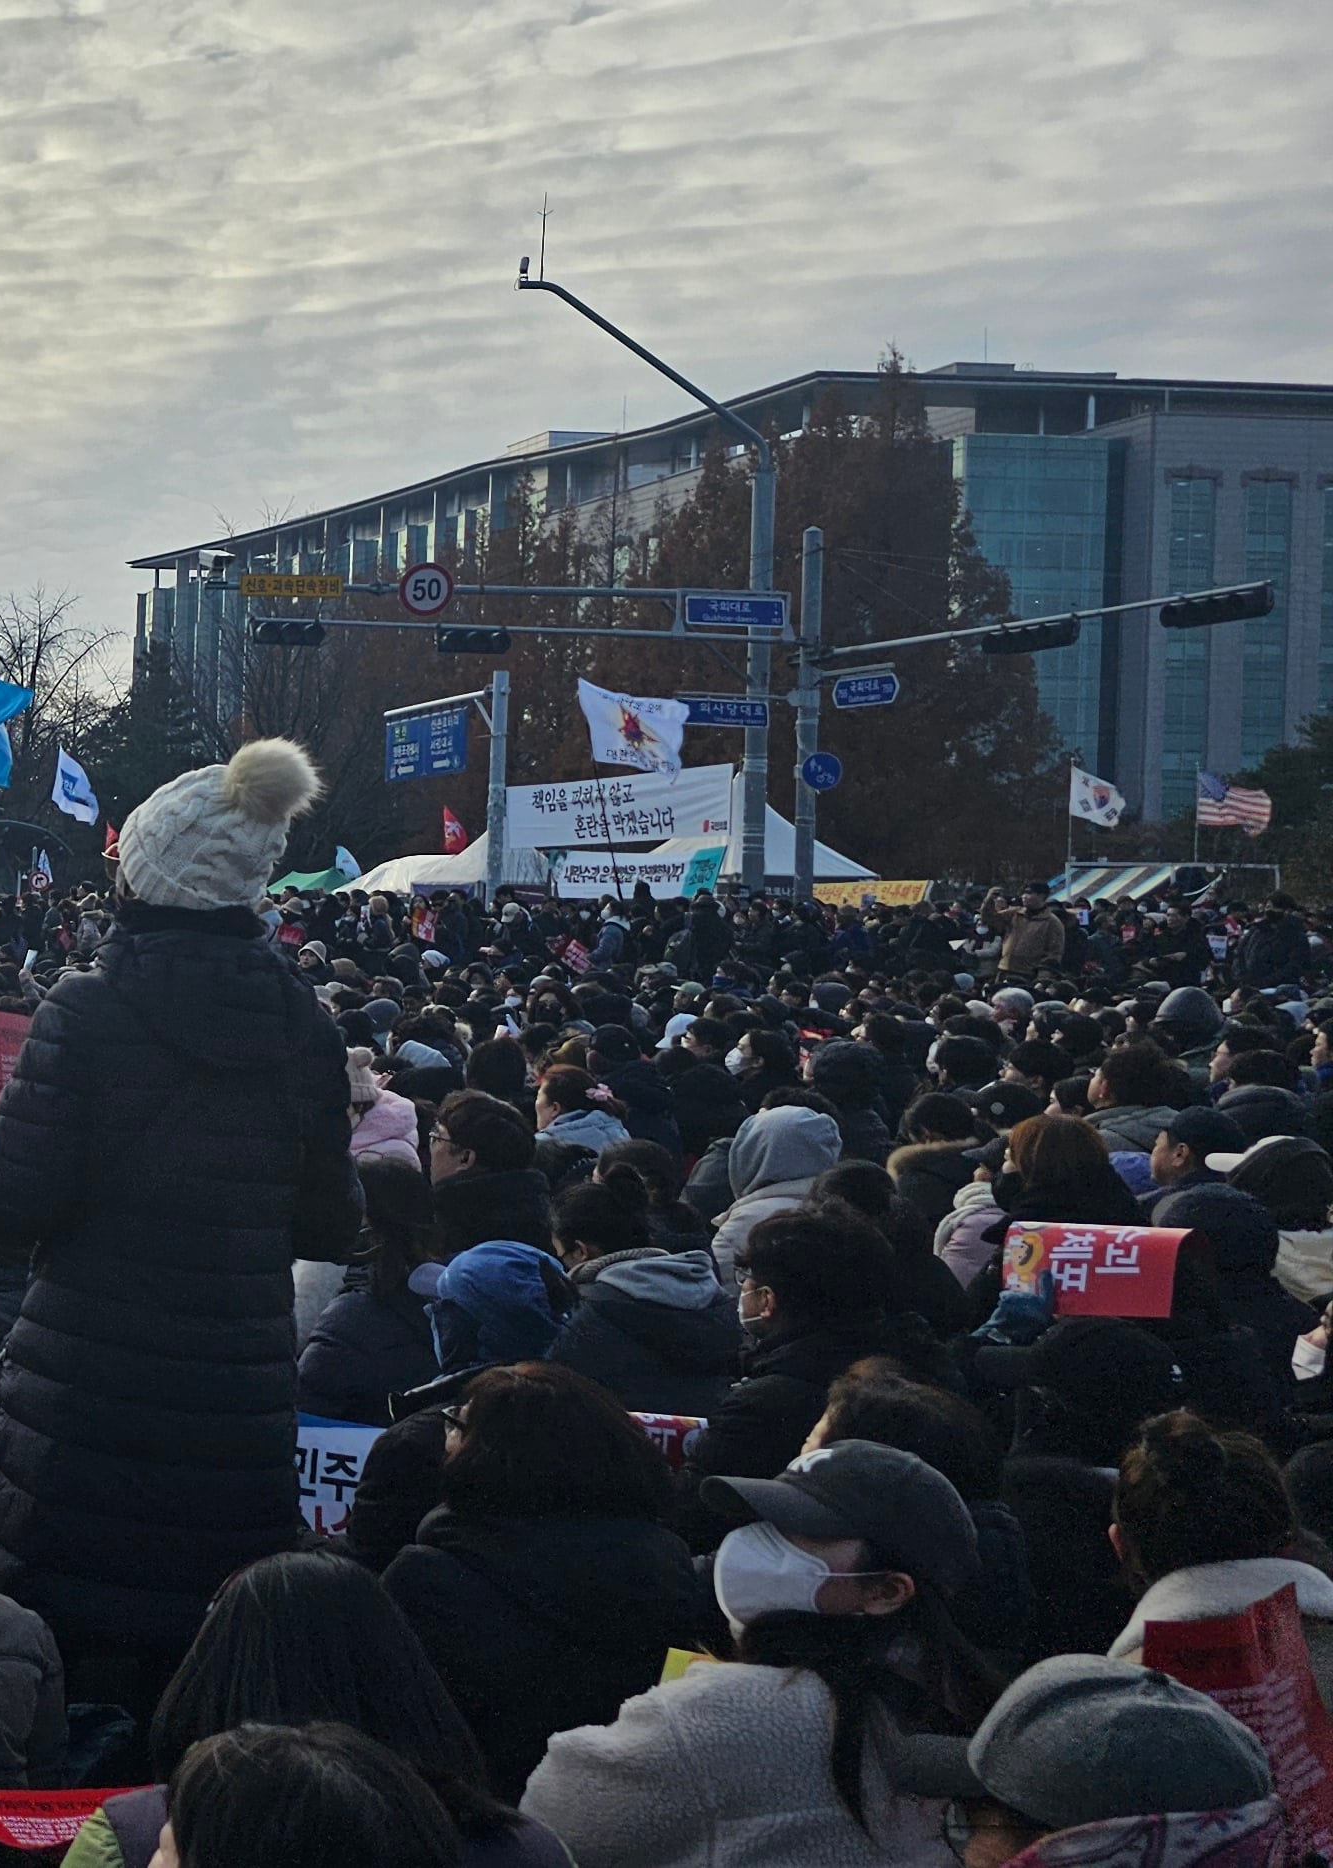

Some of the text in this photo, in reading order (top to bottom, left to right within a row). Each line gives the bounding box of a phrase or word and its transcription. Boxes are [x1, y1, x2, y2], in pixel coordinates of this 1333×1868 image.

[412, 577, 442, 602] 50
[709, 600, 751, 613] 국회대로
[700, 702, 765, 717] 의사당대로
[532, 788, 568, 814] 책임을
[608, 781, 636, 808] 않고
[574, 807, 676, 840] 혼란을 막겠습니다
[1048, 1231, 1097, 1293] 체포
